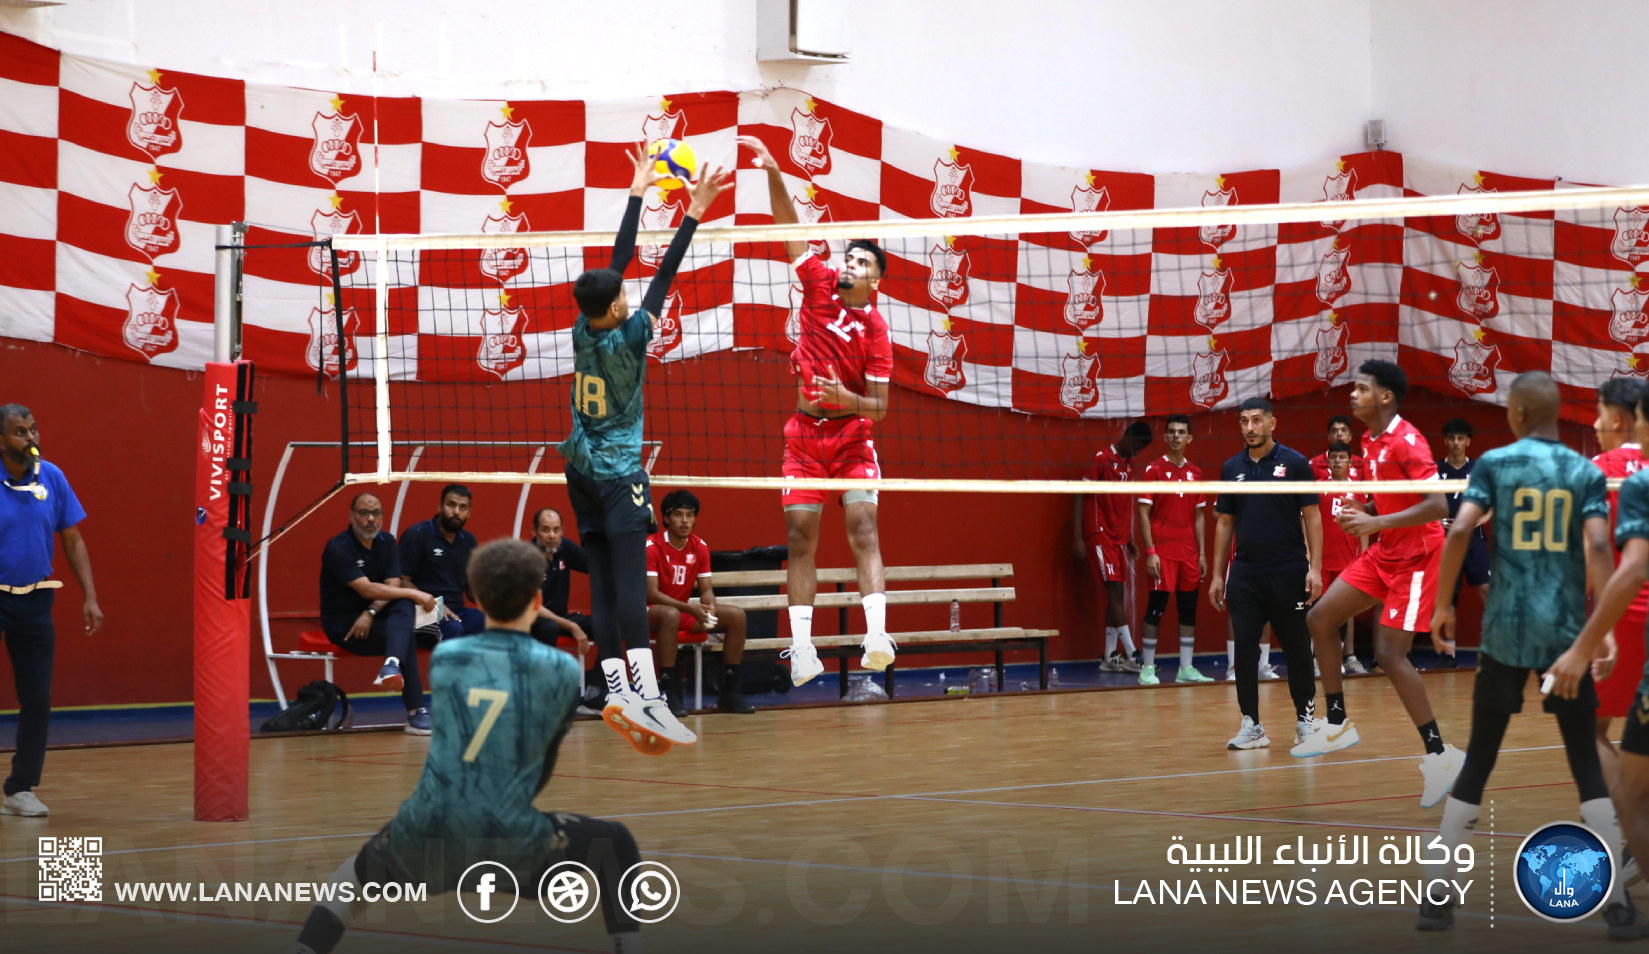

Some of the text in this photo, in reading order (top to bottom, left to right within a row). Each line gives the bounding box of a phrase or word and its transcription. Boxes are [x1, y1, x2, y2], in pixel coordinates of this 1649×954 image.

[149, 144, 161, 152] 1947
[575, 371, 607, 418] 18
[210, 384, 228, 501] VIVISPORT
[1512, 487, 1573, 552] 20
[672, 564, 687, 585] 18
[462, 687, 509, 762] 7
